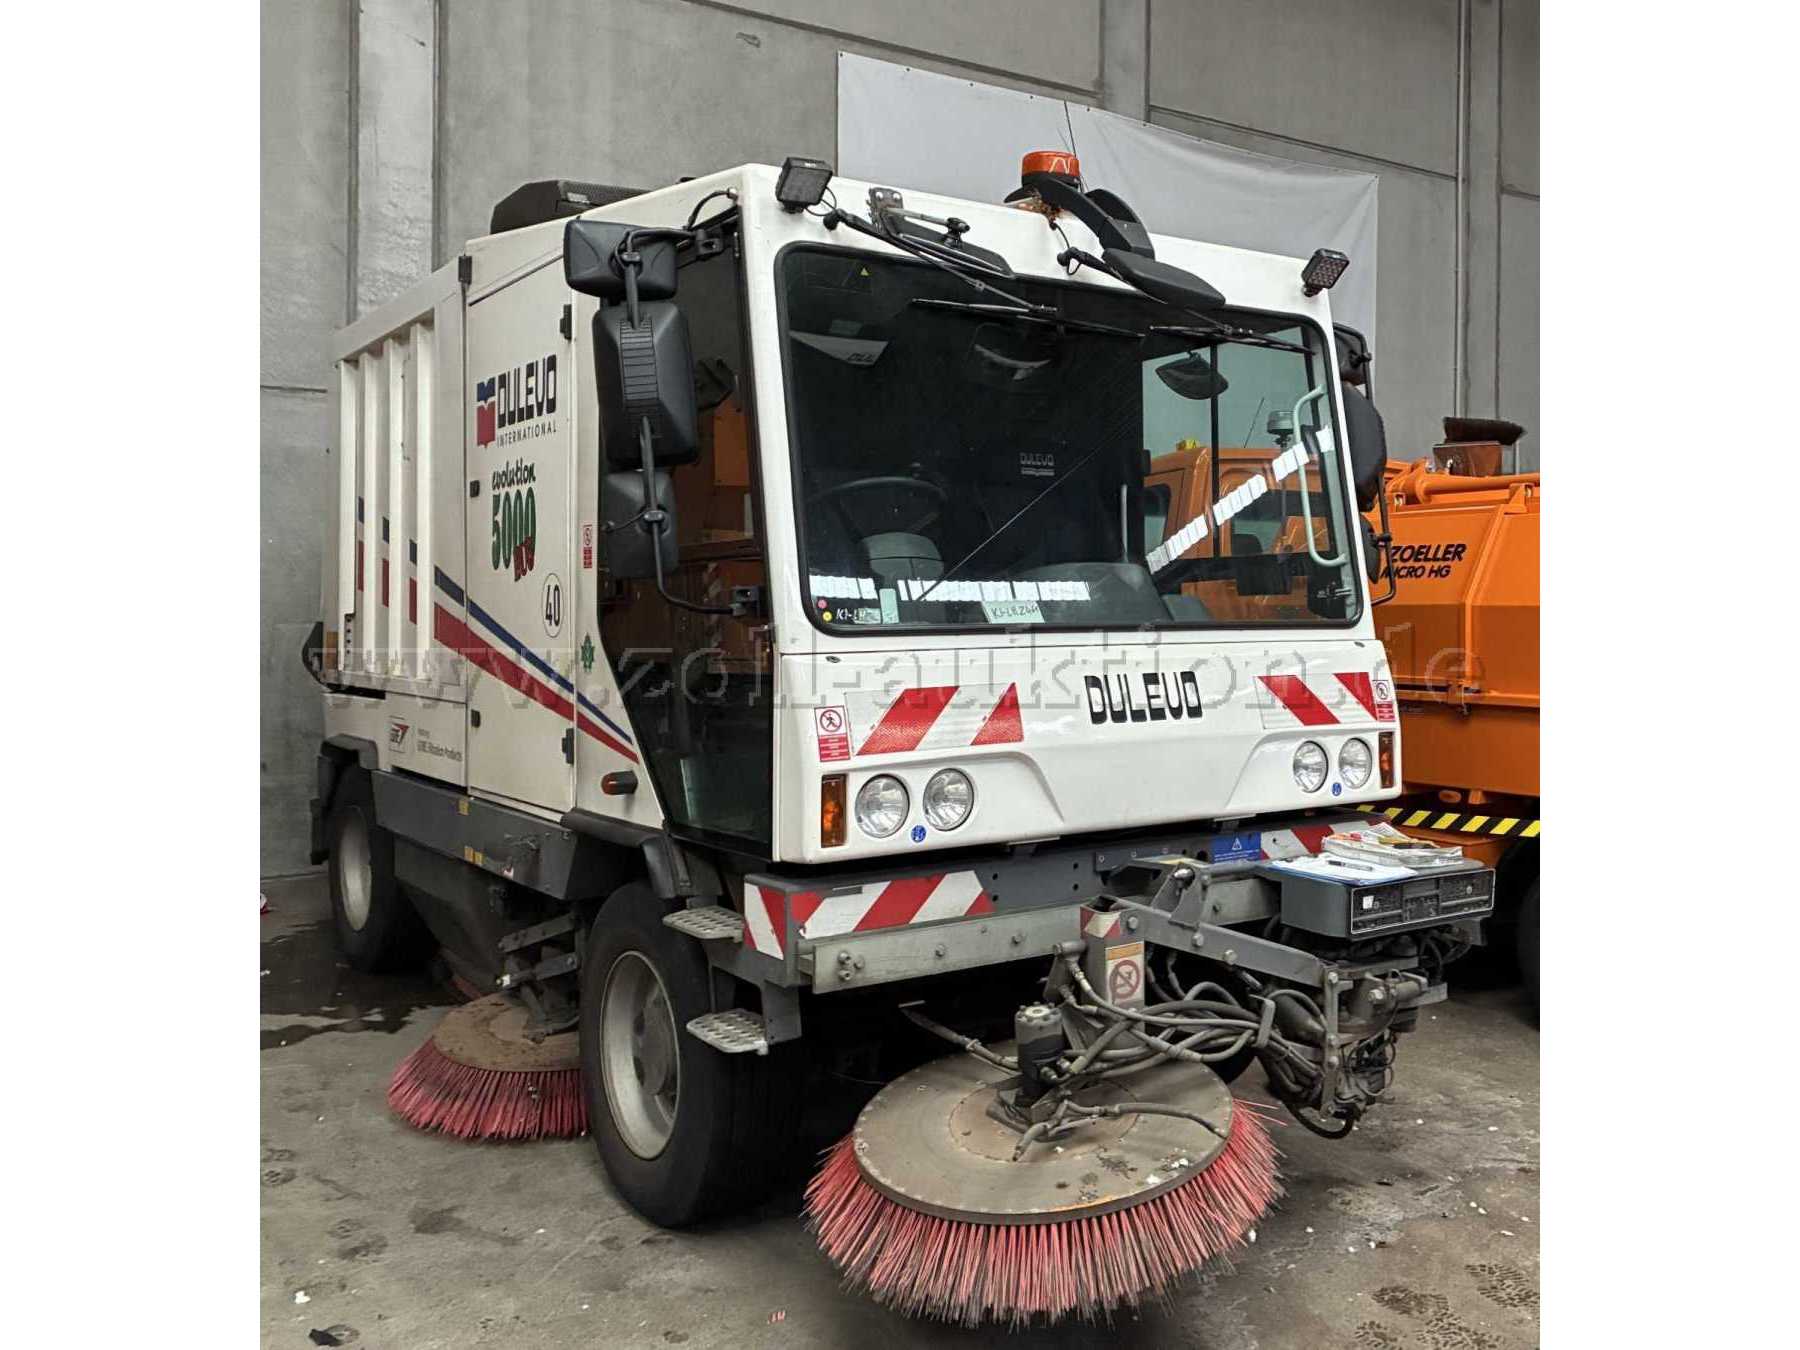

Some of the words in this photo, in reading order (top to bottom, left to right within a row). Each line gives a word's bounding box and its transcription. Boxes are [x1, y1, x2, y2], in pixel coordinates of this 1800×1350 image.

[497, 354, 557, 429] DULEVO
[497, 420, 557, 448] INTERNATIONAL
[492, 457, 537, 491] evolution
[491, 486, 537, 571] 5000
[1390, 543, 1467, 562] ZOELLER
[1428, 565, 1452, 578] HG
[545, 584, 561, 626] 40
[1084, 671, 1203, 725] DULEVO
